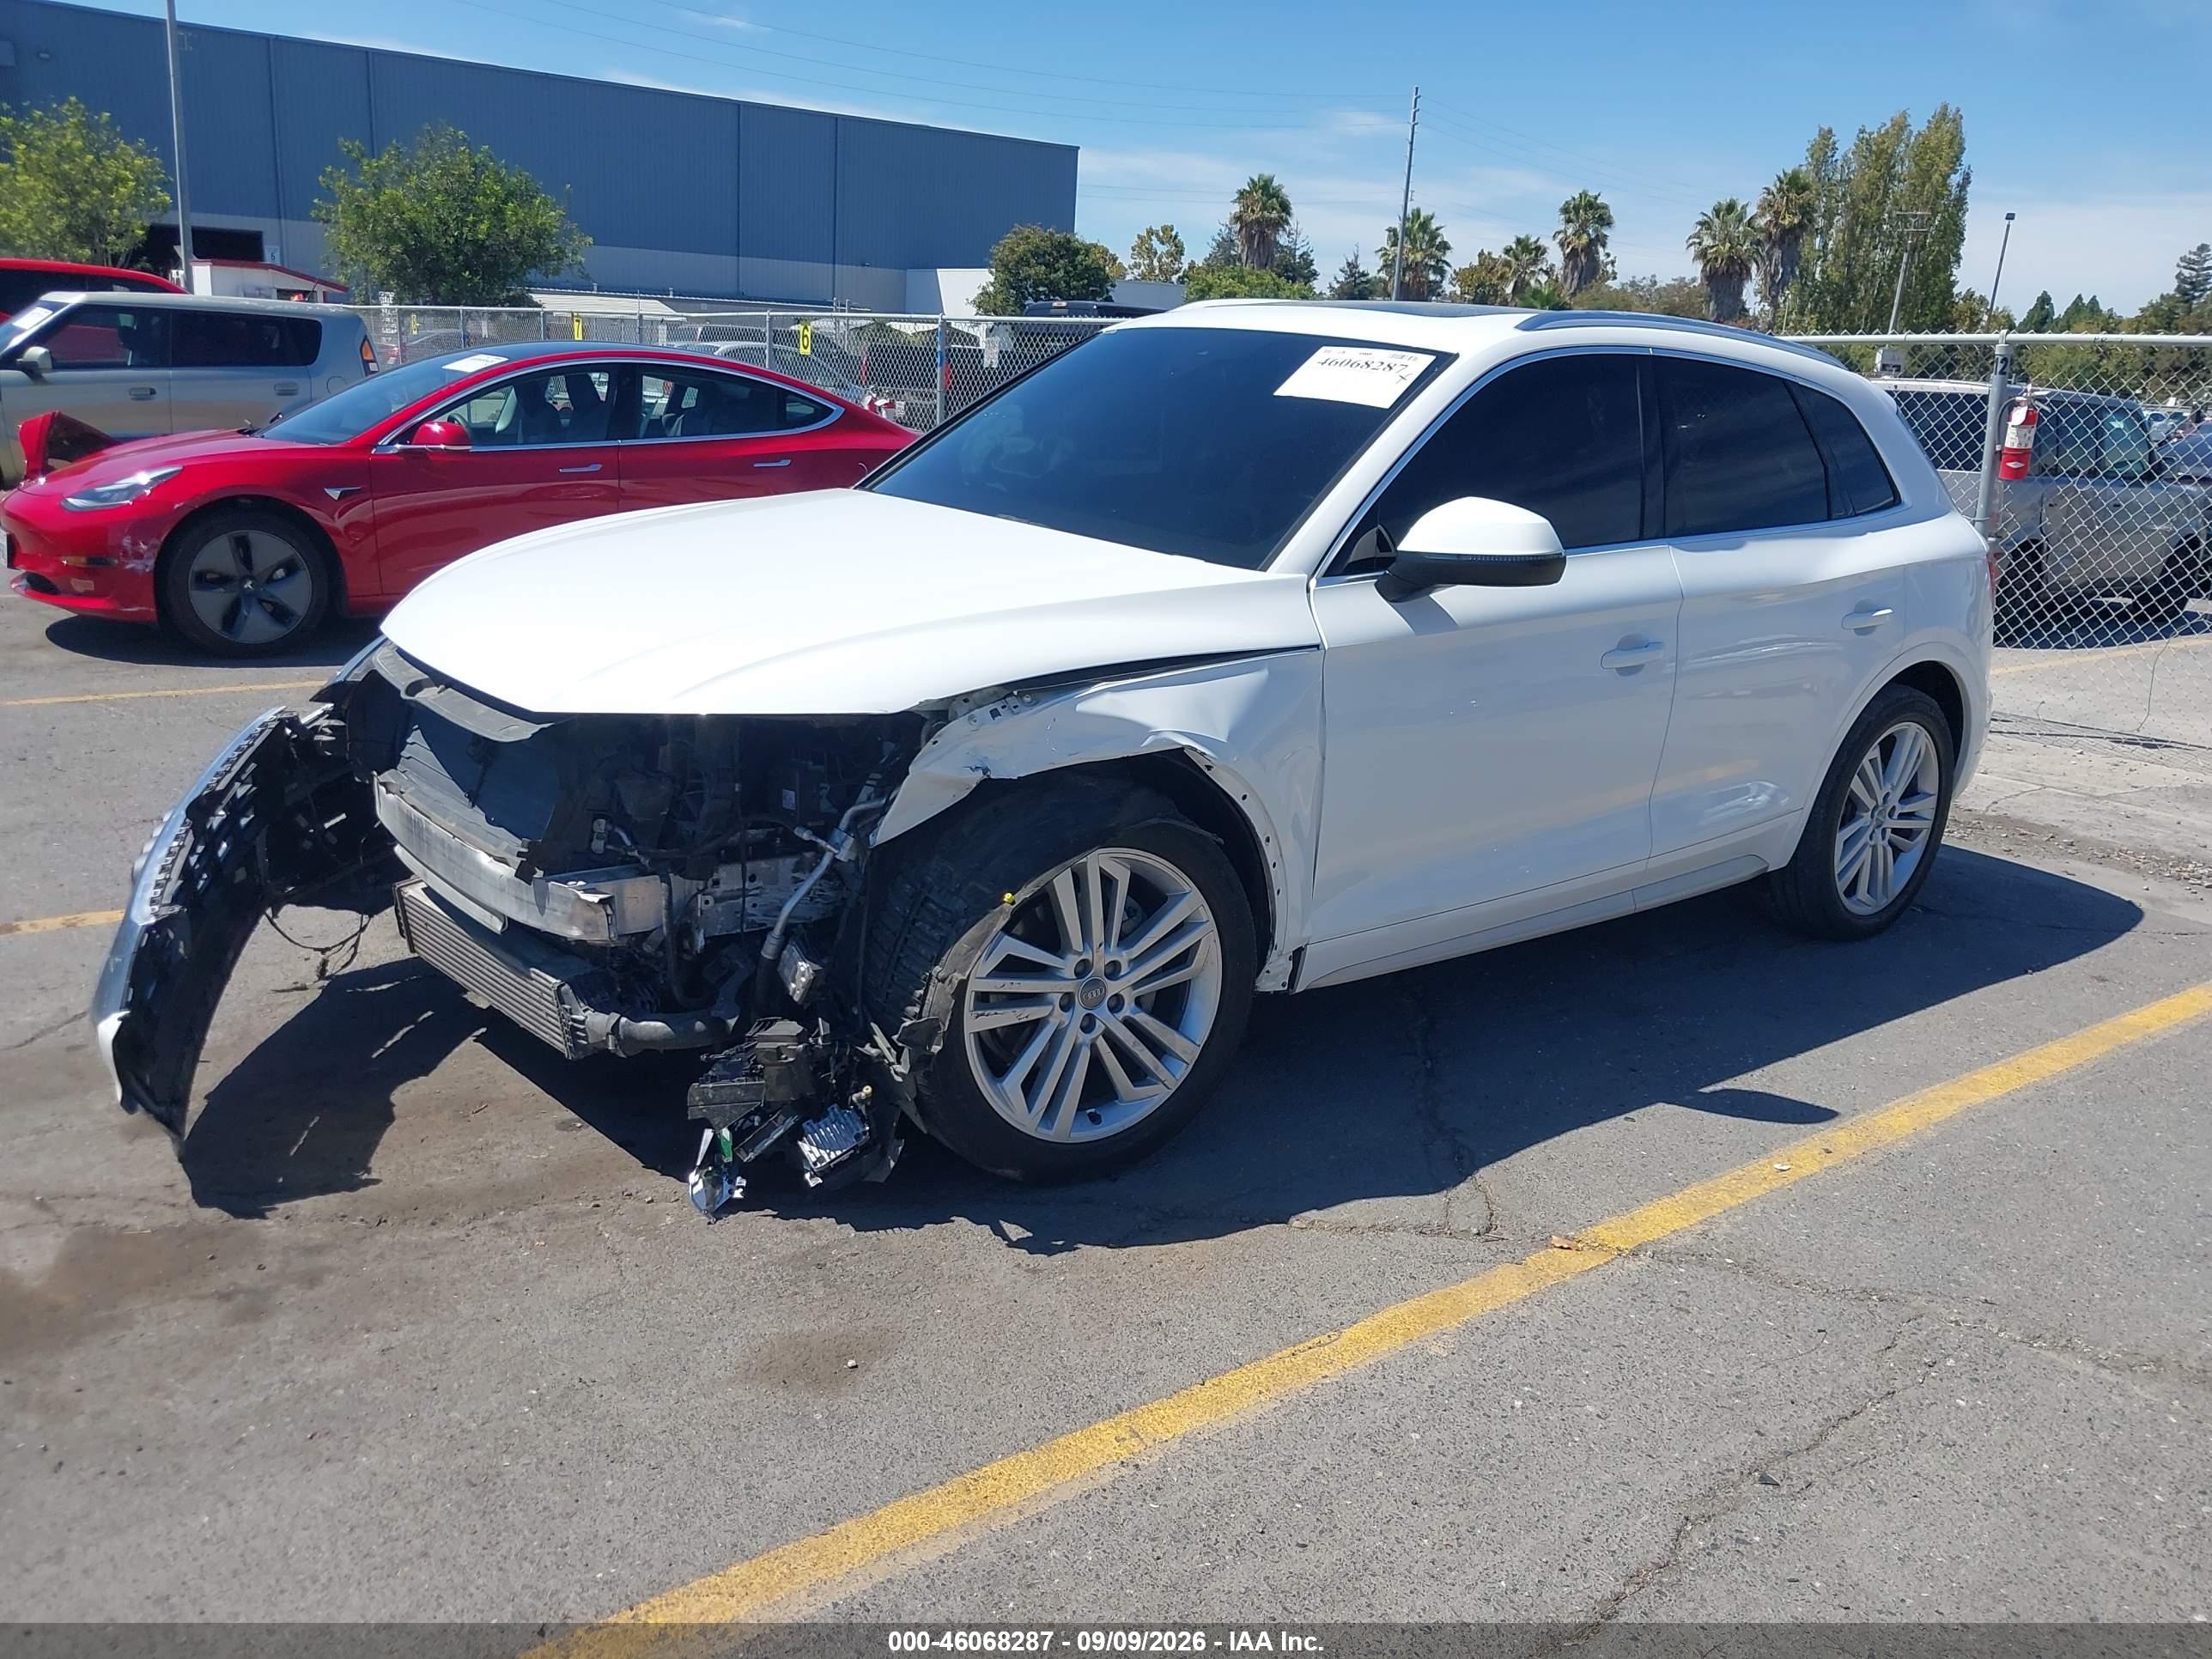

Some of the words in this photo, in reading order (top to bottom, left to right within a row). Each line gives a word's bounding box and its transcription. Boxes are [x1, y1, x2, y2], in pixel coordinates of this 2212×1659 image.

[575, 319, 580, 338] 7
[802, 325, 809, 349] 6
[1317, 357, 1409, 373] 46068287
[1994, 356, 2008, 375] 12
